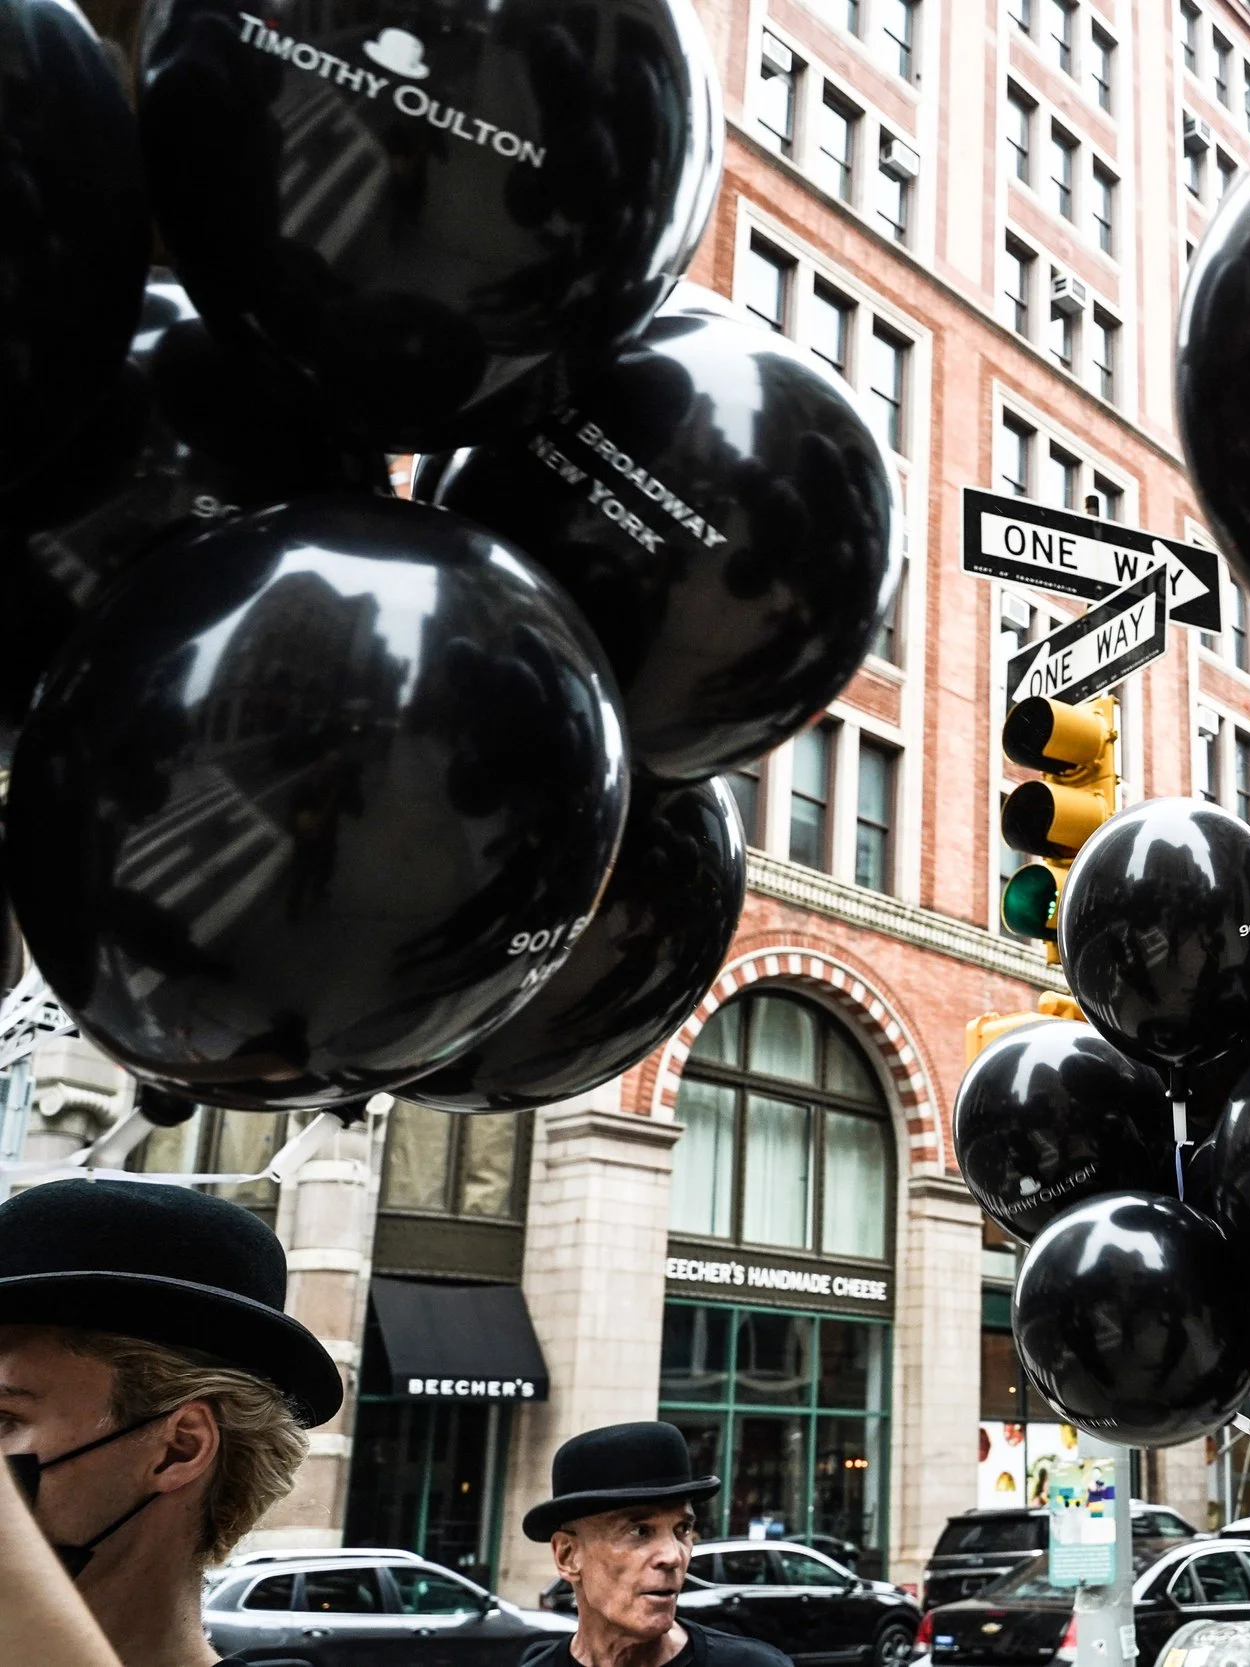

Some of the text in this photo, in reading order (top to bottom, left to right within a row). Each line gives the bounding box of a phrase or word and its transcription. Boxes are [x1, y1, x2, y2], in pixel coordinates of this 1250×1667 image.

[239, 12, 546, 168] TIMOTHY OULTON
[576, 420, 728, 548] BROADWAY
[587, 478, 666, 554] YORK
[1004, 525, 1184, 596] ONE WY
[1030, 650, 1073, 697] ONE
[1097, 605, 1145, 664] WAY
[507, 924, 566, 955] 901
[1040, 1163, 1096, 1202] OULTON
[747, 1266, 831, 1296] HANDMADE
[832, 1276, 887, 1301] CHEESE
[408, 1378, 535, 1397] BEECHER'S
